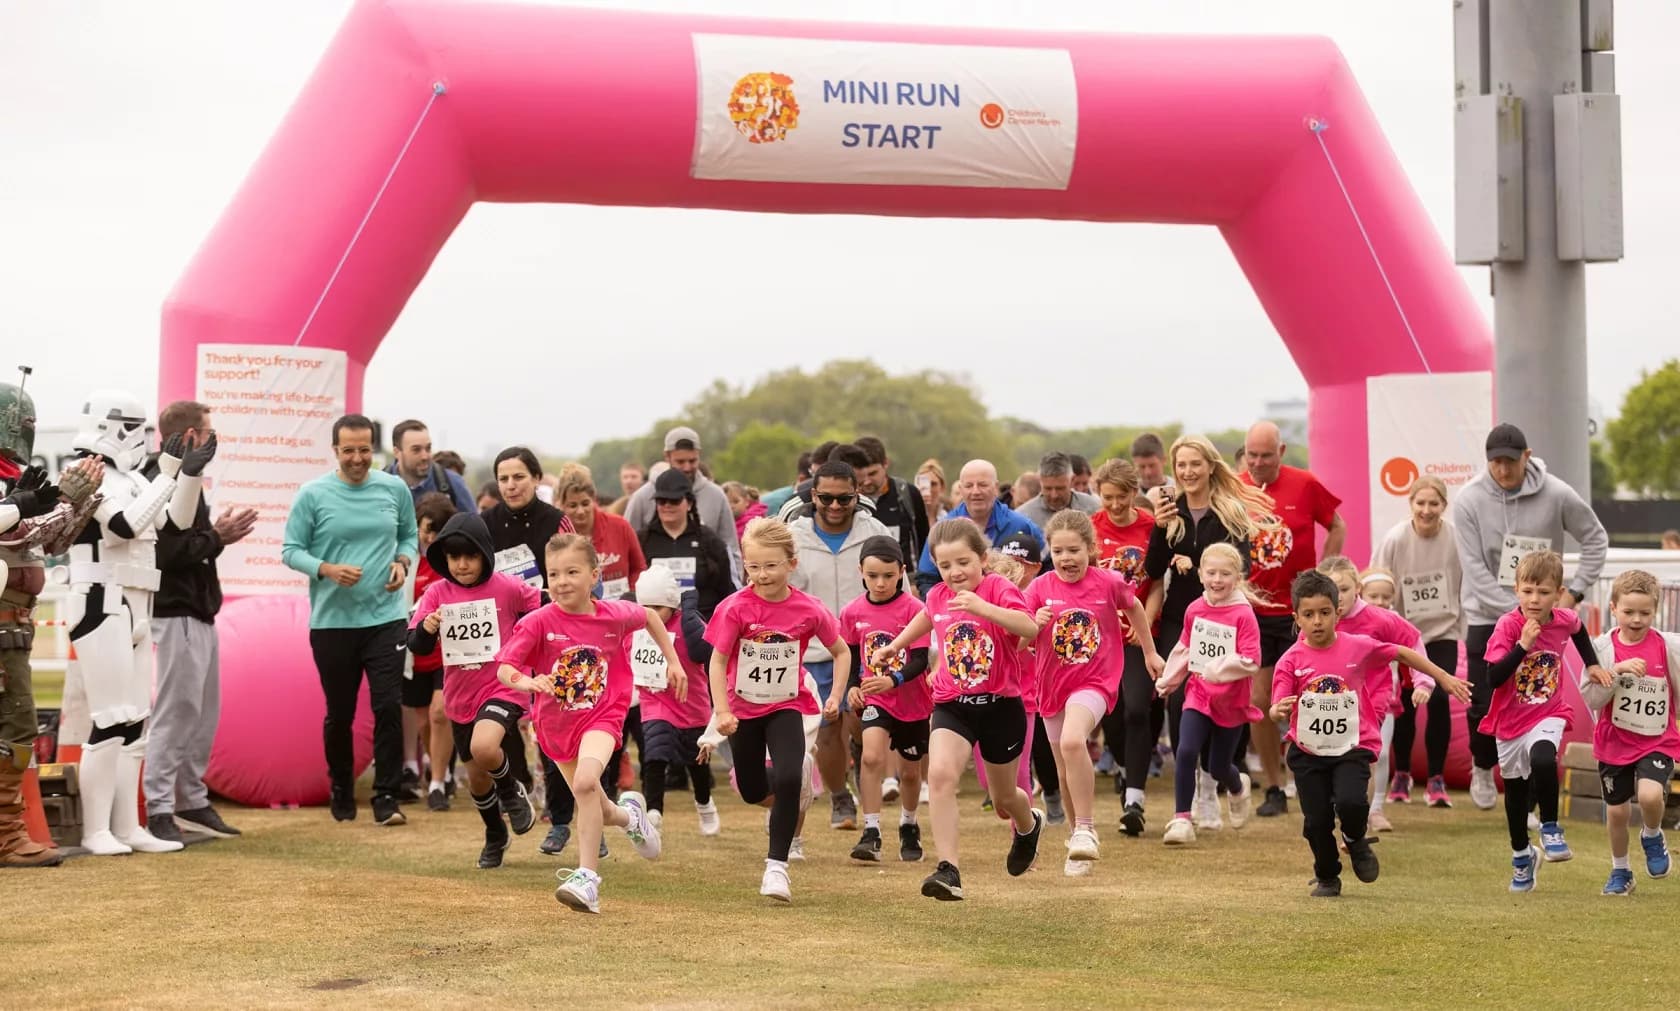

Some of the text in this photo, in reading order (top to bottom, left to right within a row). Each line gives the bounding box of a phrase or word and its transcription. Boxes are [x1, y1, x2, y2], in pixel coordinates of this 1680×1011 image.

[823, 80, 960, 107] MINI RUN
[842, 122, 942, 149] START
[205, 352, 322, 369] Thank you for your
[204, 368, 261, 381] support!
[204, 389, 239, 400] You're
[241, 391, 283, 403] making
[285, 392, 302, 403] life
[220, 404, 268, 416] children
[270, 407, 296, 417] with
[255, 435, 278, 445] and
[280, 436, 298, 448] tag
[1412, 587, 1439, 602] 362
[460, 612, 478, 620] RUN
[446, 621, 494, 640] 4282
[635, 648, 665, 666] 4284
[1198, 641, 1226, 658] 380
[748, 666, 787, 683] 417
[1638, 685, 1656, 693] RUN
[955, 695, 989, 705] IKE
[1619, 696, 1666, 716] 2163
[1309, 718, 1348, 735] 405
